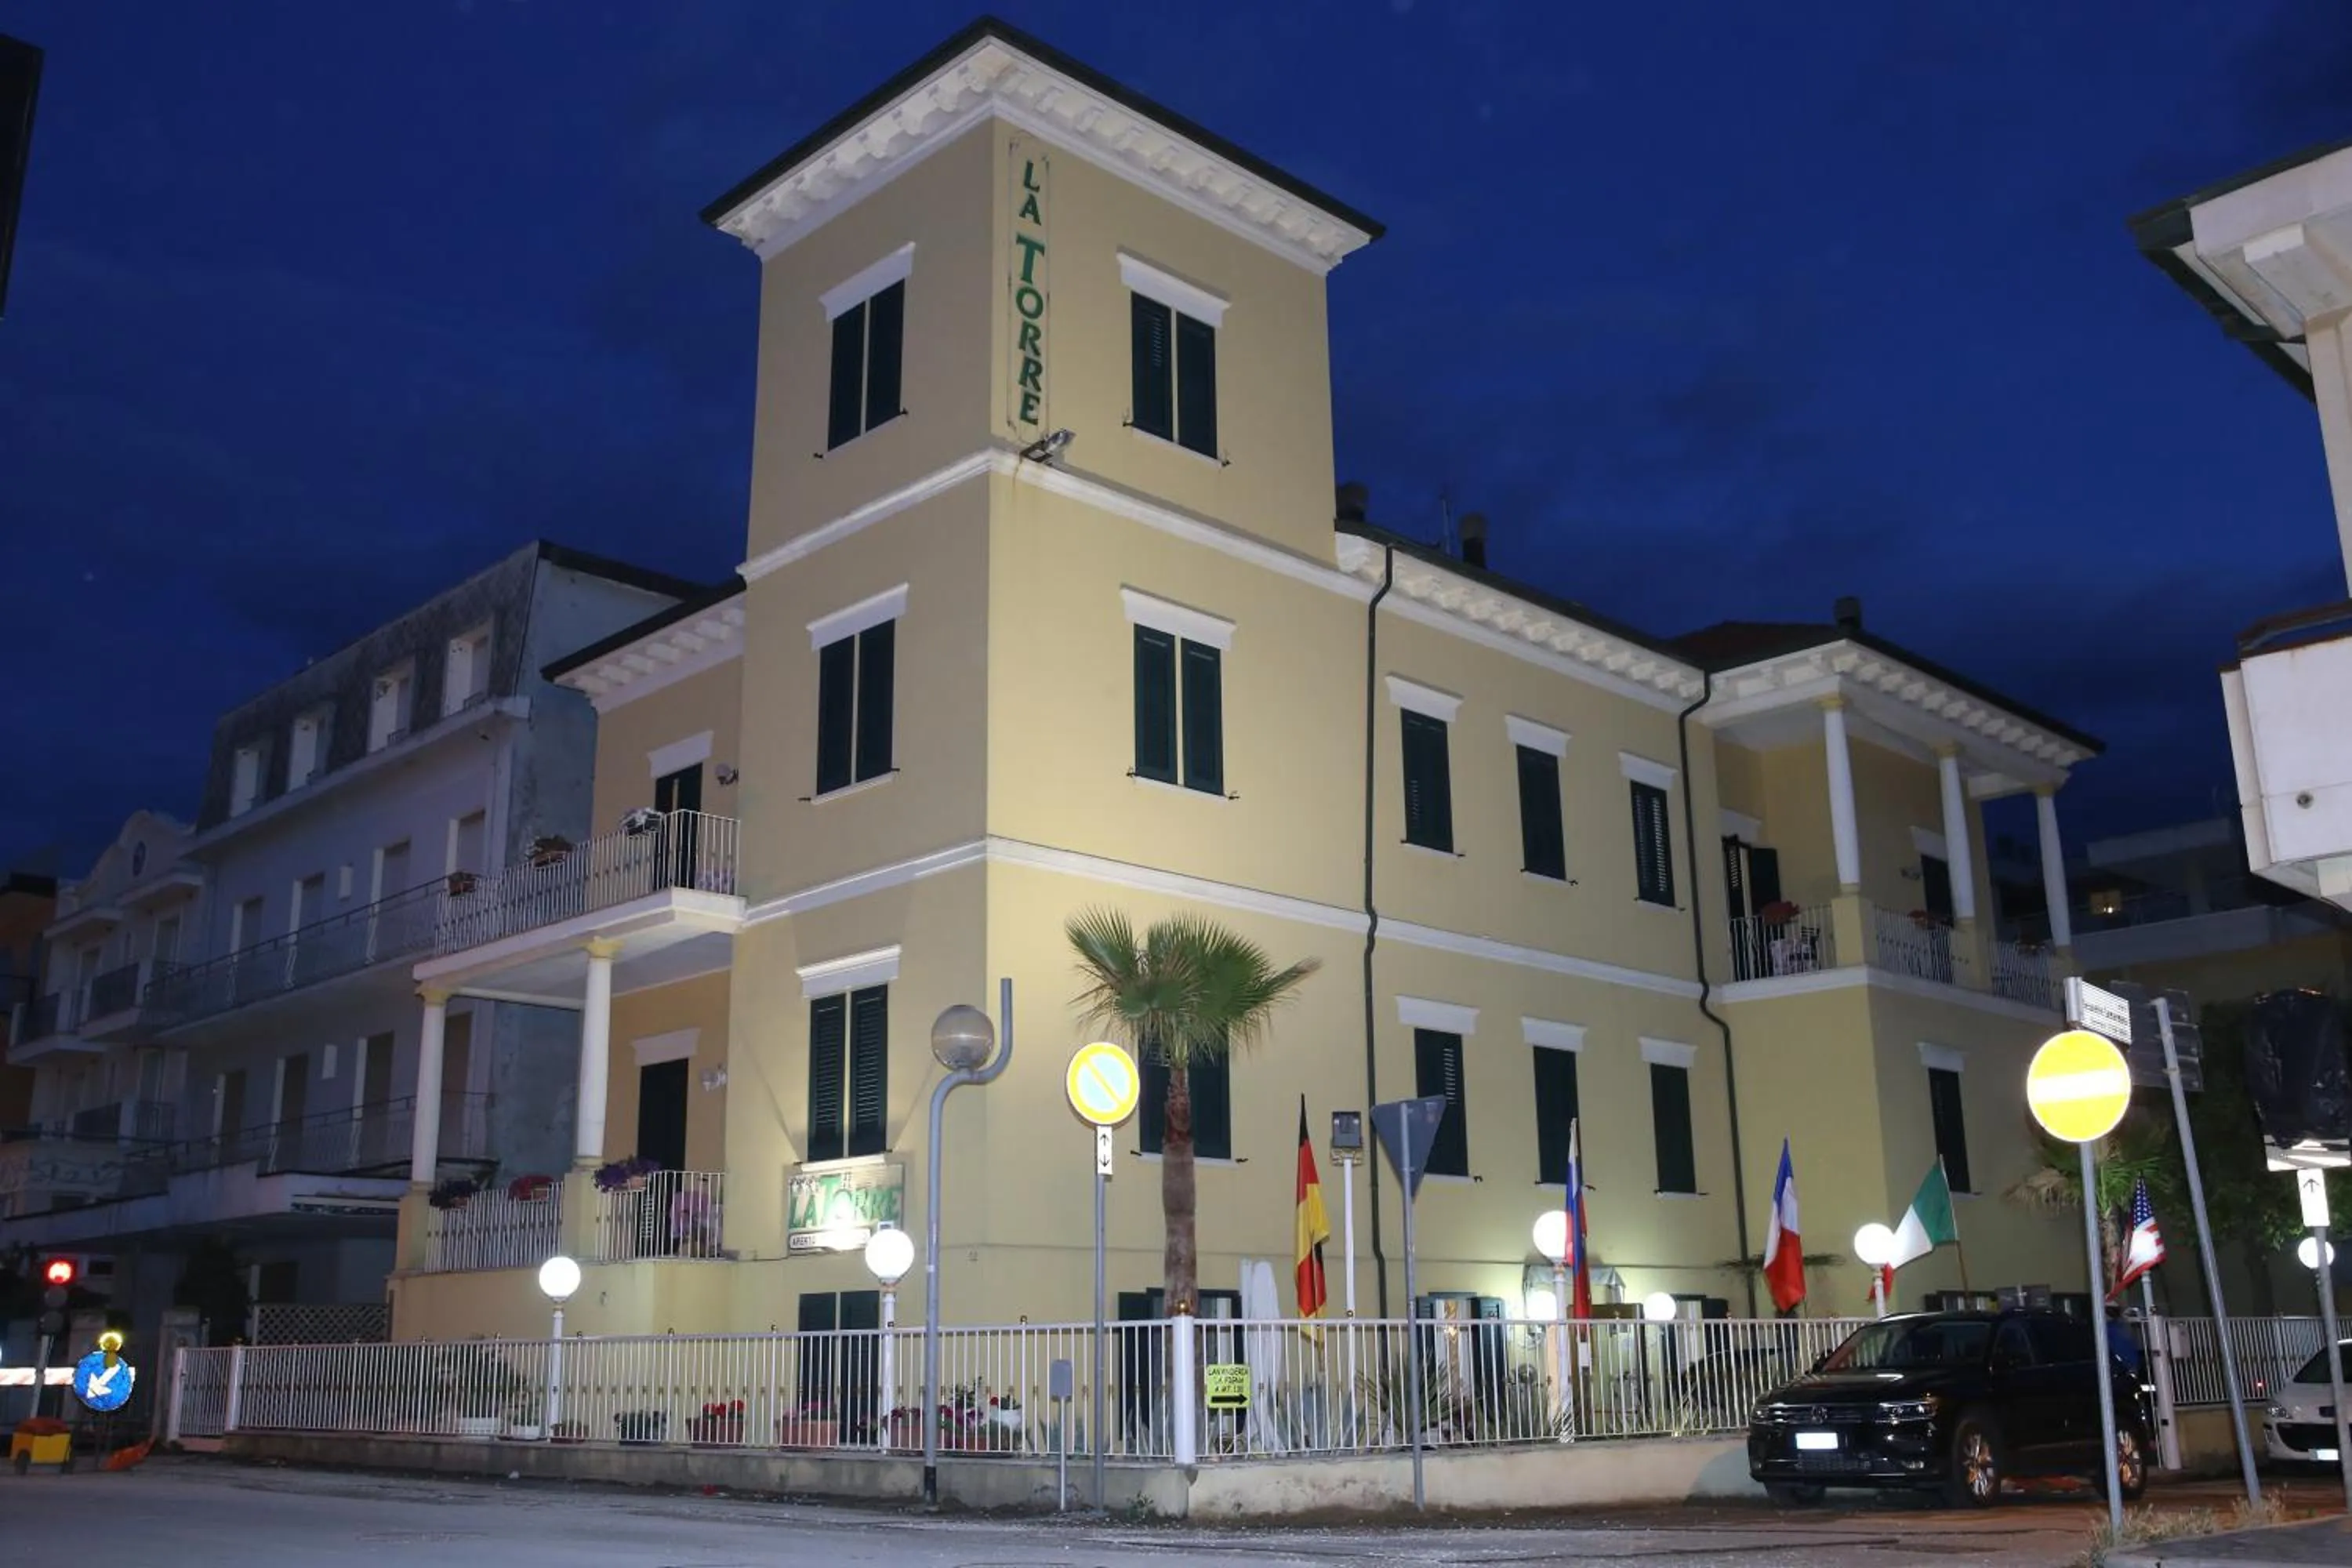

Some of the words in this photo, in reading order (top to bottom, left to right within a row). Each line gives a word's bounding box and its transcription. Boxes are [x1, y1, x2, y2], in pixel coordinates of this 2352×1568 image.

[1019, 160, 1041, 226] LA
[1015, 233, 1046, 425] TORRE
[789, 1190, 817, 1229] LA
